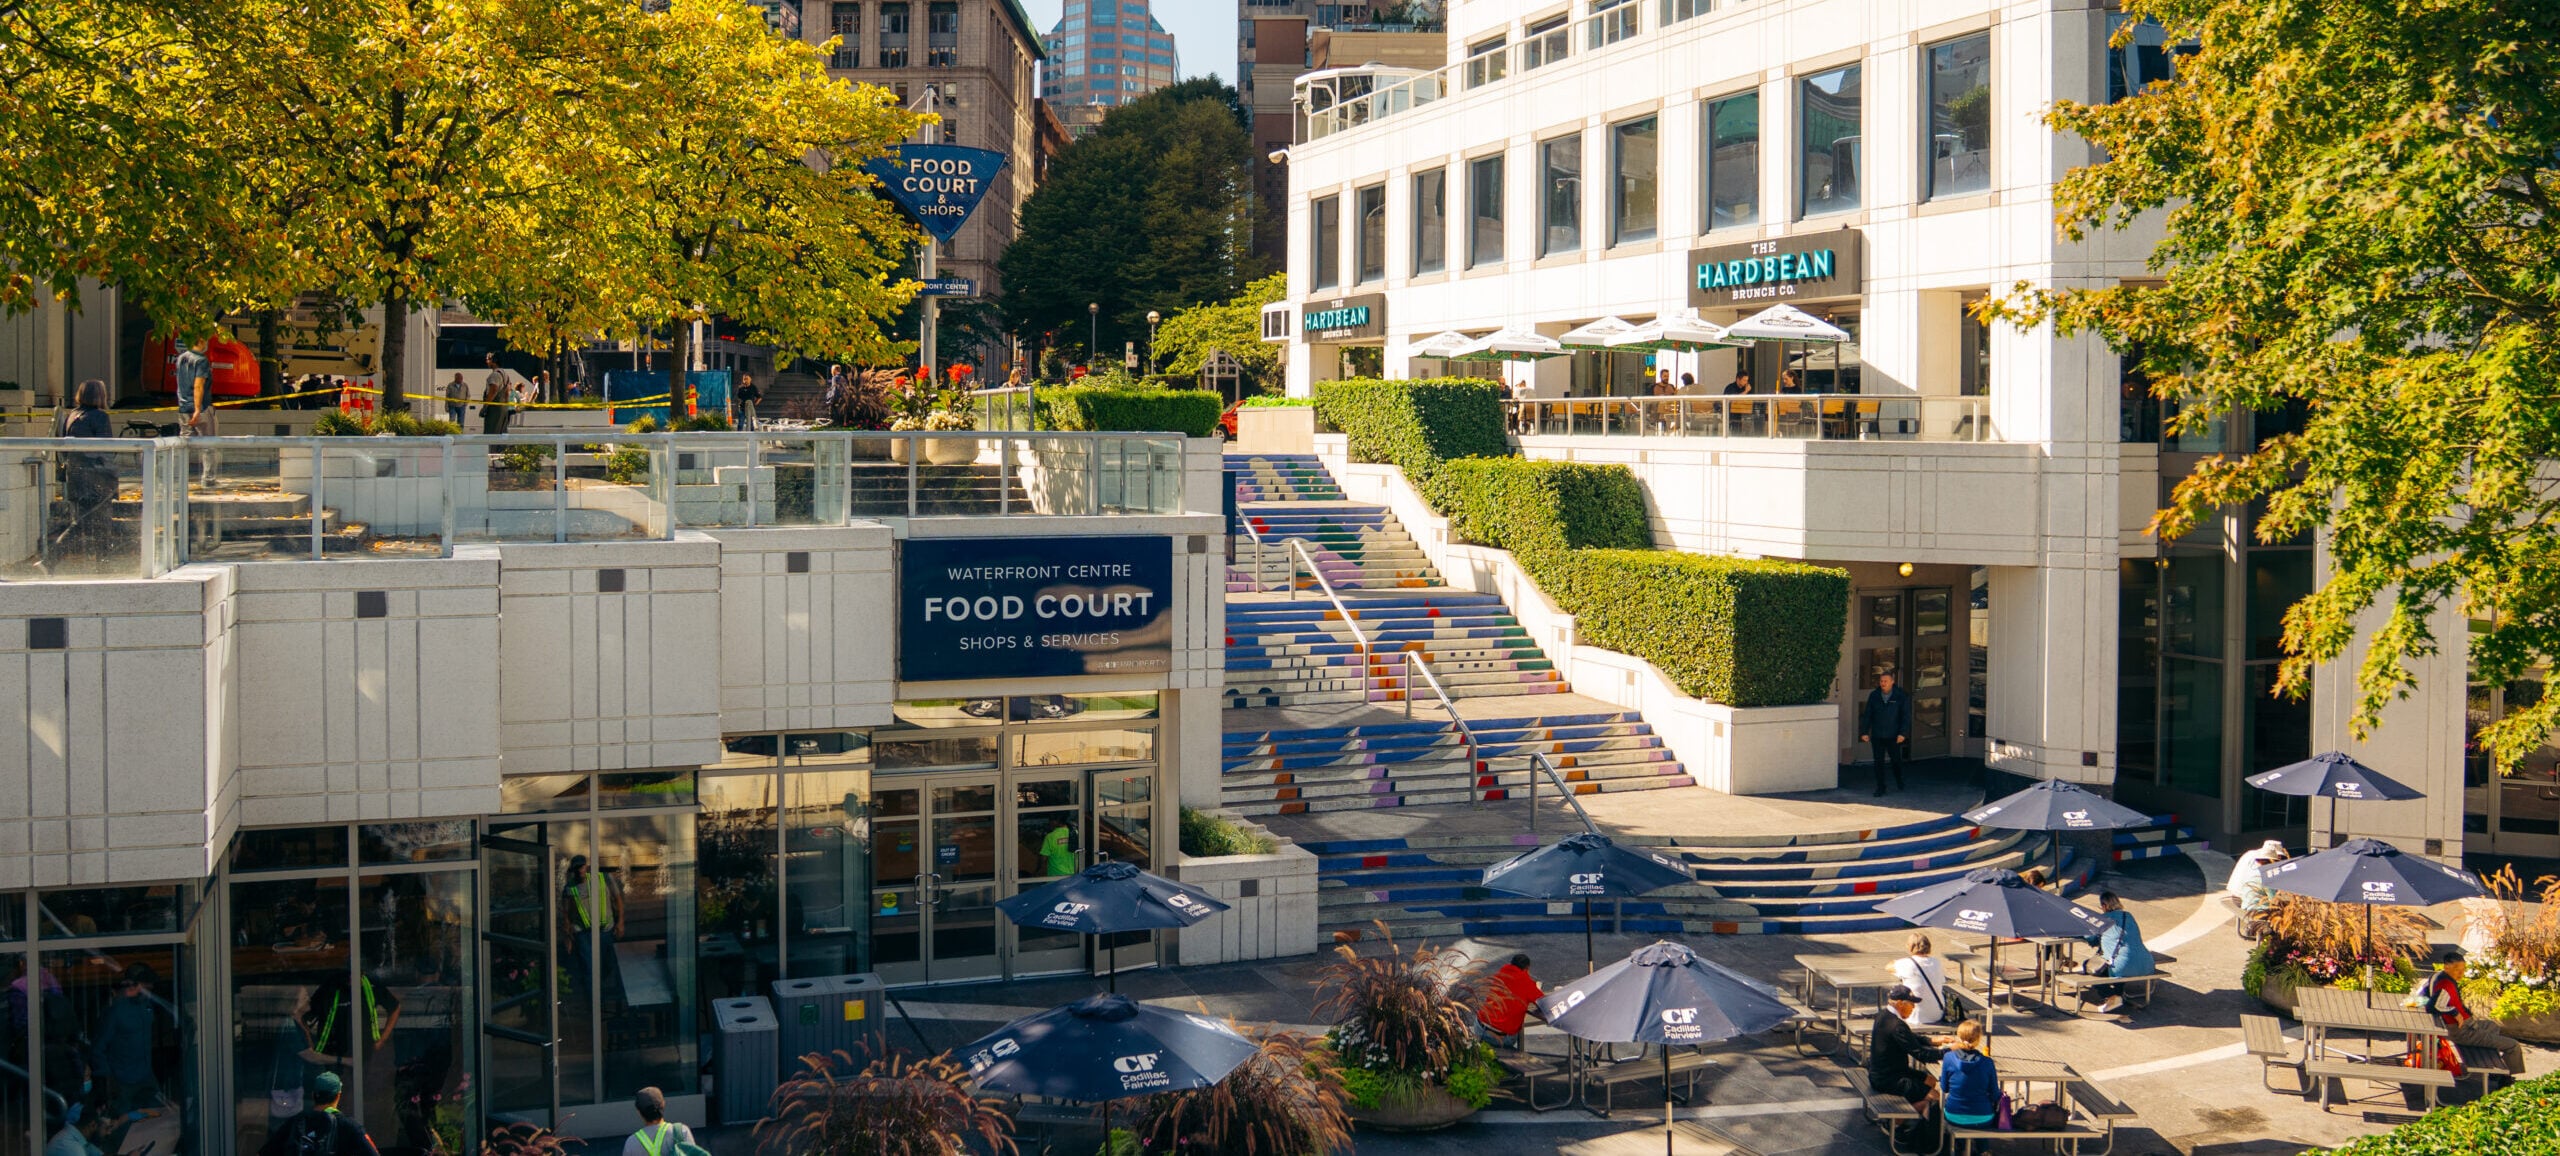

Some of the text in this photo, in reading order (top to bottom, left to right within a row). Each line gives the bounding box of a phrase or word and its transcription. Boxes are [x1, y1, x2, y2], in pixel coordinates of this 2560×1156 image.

[910, 158, 972, 175] FOOD
[903, 177, 979, 194] COURT
[937, 193, 947, 205] &
[919, 204, 965, 216] SHOPS
[1751, 240, 1777, 255] THE
[1696, 248, 1834, 289] HARDBEAN
[1732, 285, 1796, 300] BRUNCH CO.
[1331, 299, 1344, 309] THE
[1304, 306, 1369, 332] HARDBEAN
[948, 564, 1132, 580] WATERFRONT CENTRE
[925, 592, 1153, 622] FOOD COURT
[959, 632, 1120, 650] SHOPS & SERVICES
[1121, 658, 1168, 669] PROPERTY
[2335, 782, 2360, 791] CF
[2062, 810, 2089, 820] CF
[1569, 873, 1604, 884] CF
[2361, 881, 2394, 892] CF
[1054, 901, 1090, 915] CF
[1047, 912, 1080, 921] Cadillac
[1958, 908, 1994, 921] CF
[1042, 917, 1077, 927] Fairview
[1661, 1007, 1698, 1024] CF
[1663, 1024, 1701, 1032] Cadillac
[1664, 1031, 1703, 1040] Fairview
[1113, 1053, 1159, 1073] CF
[1120, 1071, 1167, 1083] Cadillac
[1123, 1078, 1170, 1090] Fairview
